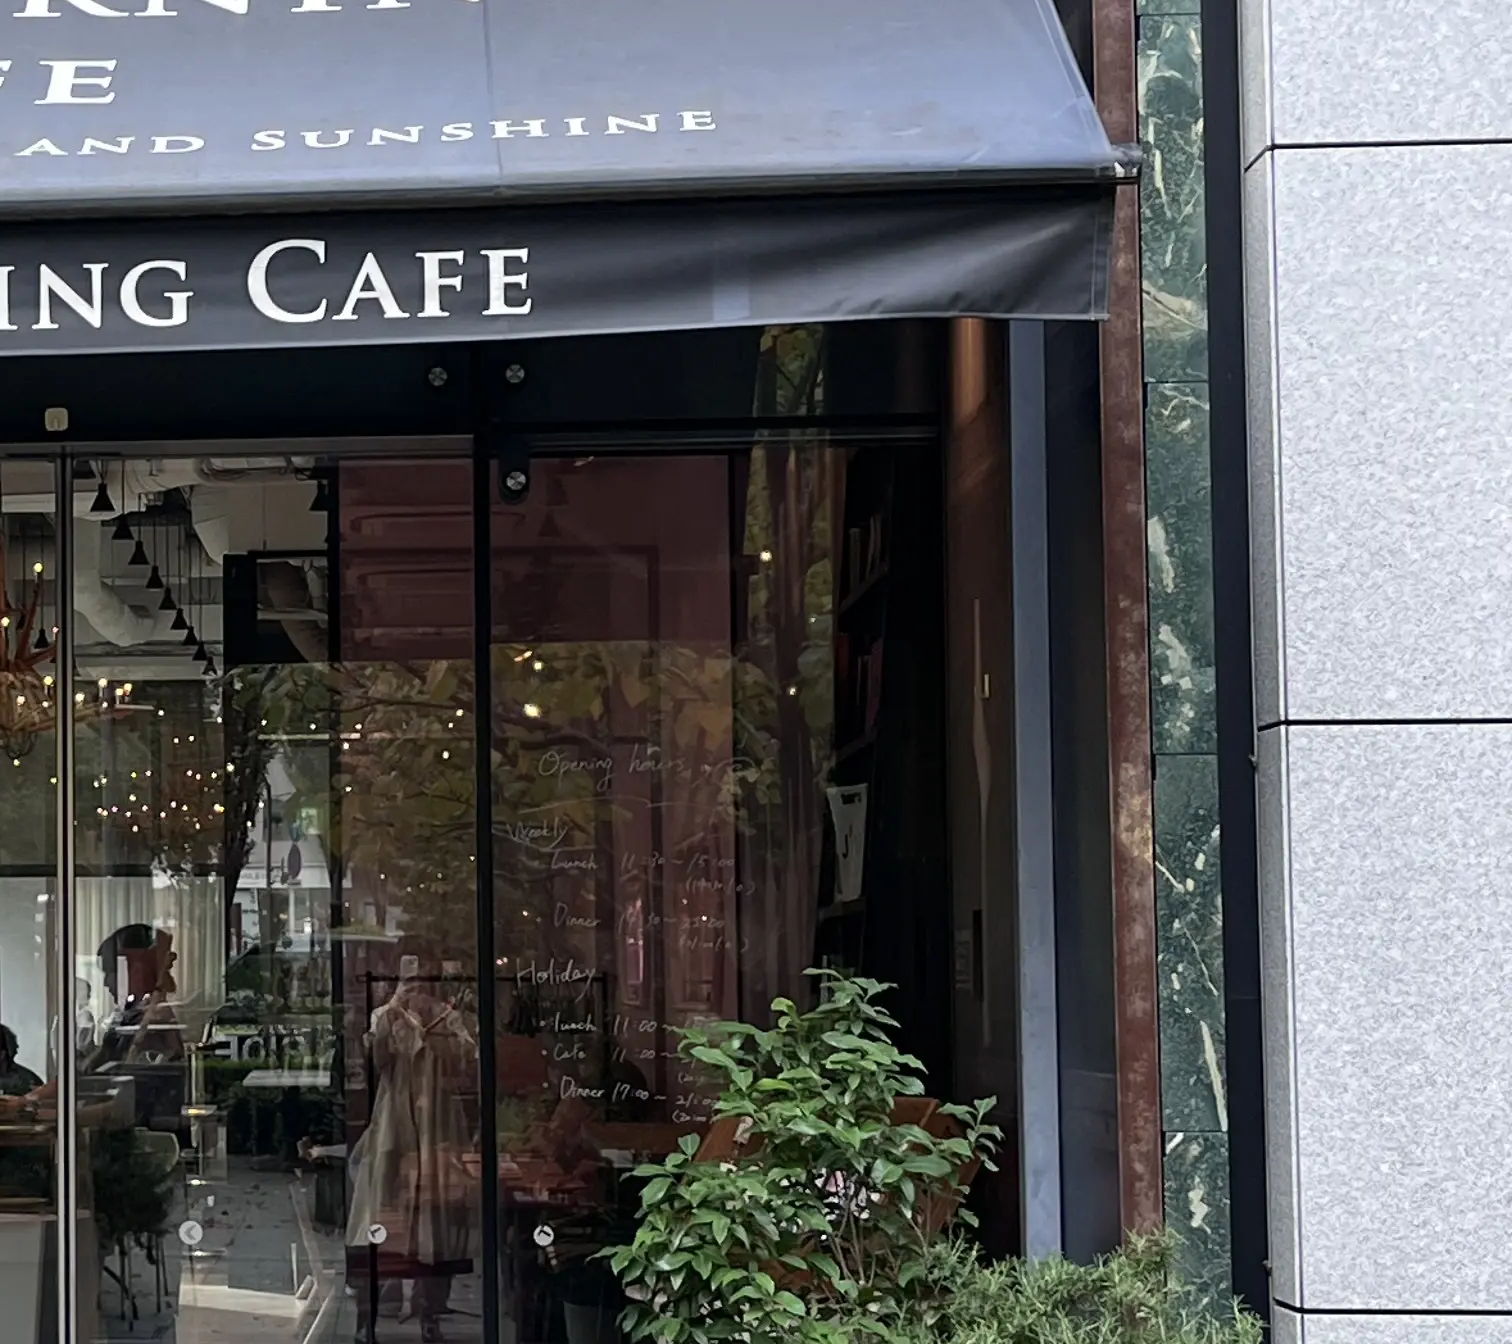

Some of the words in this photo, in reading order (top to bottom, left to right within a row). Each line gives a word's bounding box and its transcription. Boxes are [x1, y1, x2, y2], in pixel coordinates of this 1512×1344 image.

[13, 135, 205, 156] AND
[250, 110, 717, 151] SUNSHINE
[247, 238, 532, 324] CAFE
[538, 749, 616, 793] Opening
[516, 957, 596, 1004] Holiday
[559, 1075, 605, 1100] Dinner
